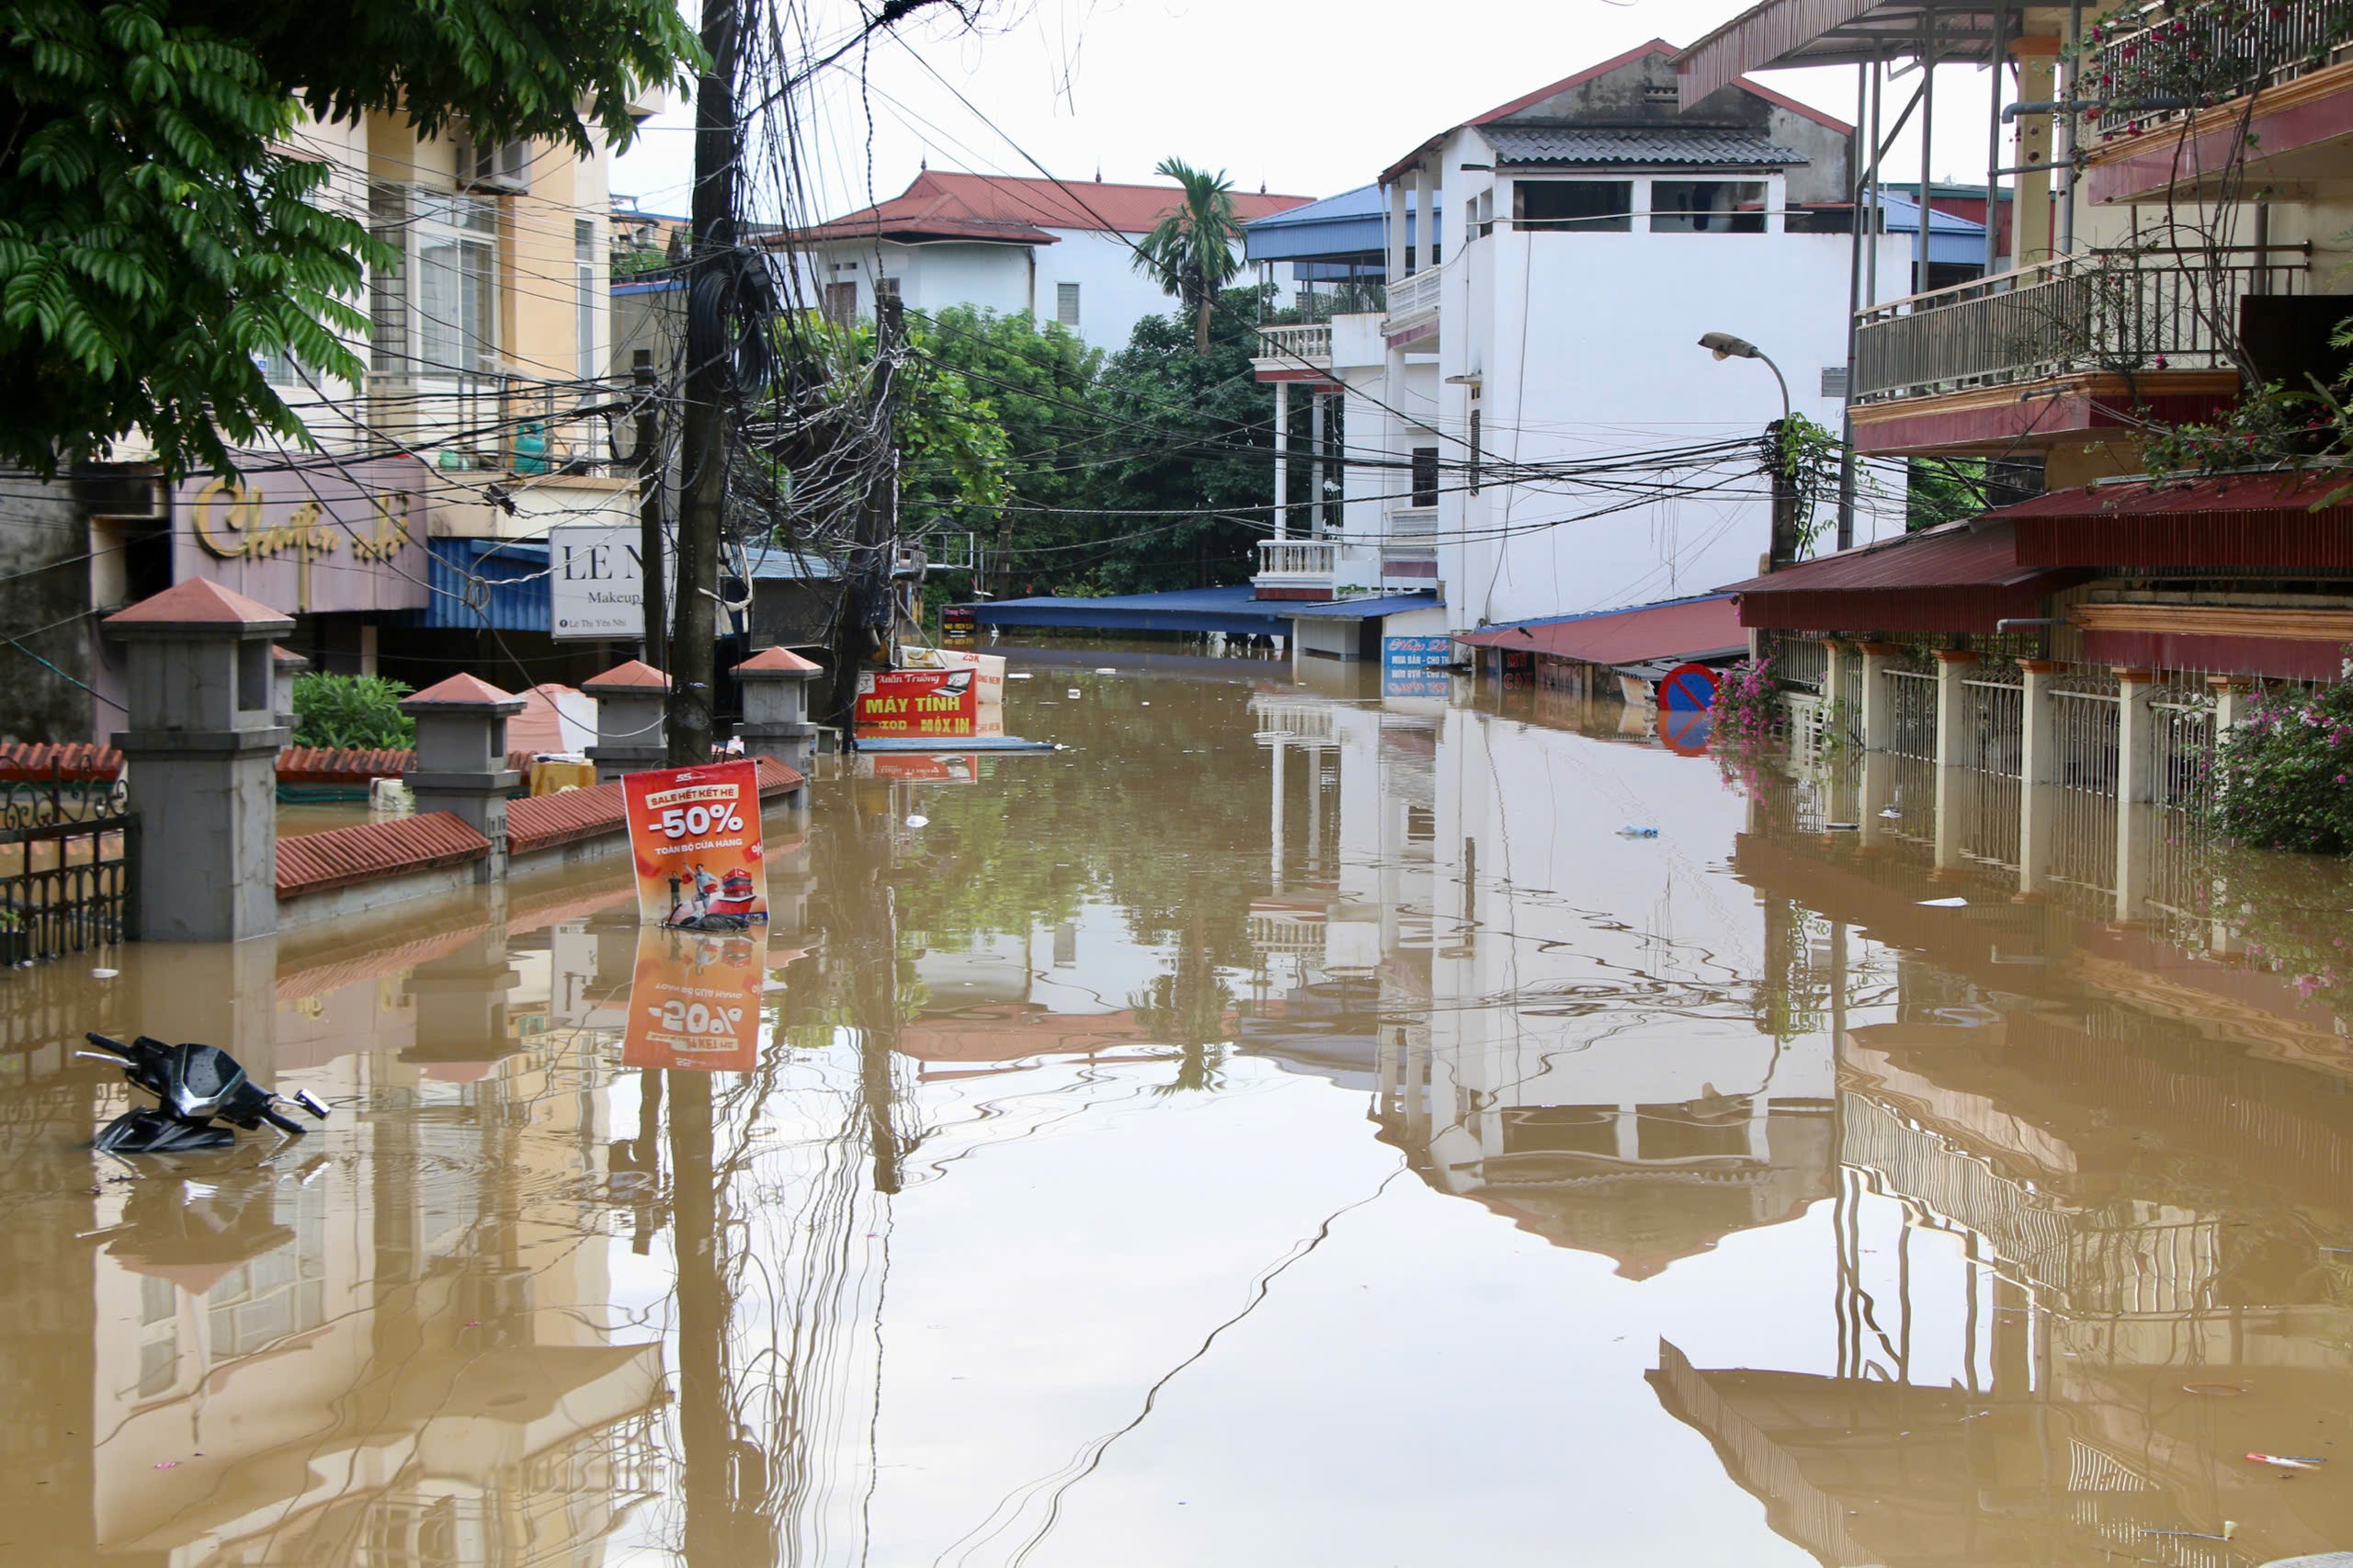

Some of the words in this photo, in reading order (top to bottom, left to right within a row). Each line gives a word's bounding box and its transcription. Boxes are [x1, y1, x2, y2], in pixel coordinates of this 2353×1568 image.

[563, 544, 613, 580] LE
[588, 591, 640, 605] Makeup
[865, 696, 909, 714] MÁY
[915, 695, 961, 713] TÍNH
[651, 794, 677, 806] SALE
[678, 789, 698, 801] HẾT
[699, 787, 719, 798] KẾT
[648, 802, 745, 838] -50%
[654, 844, 681, 856] TOÀN
[715, 837, 744, 848] HÀNG
